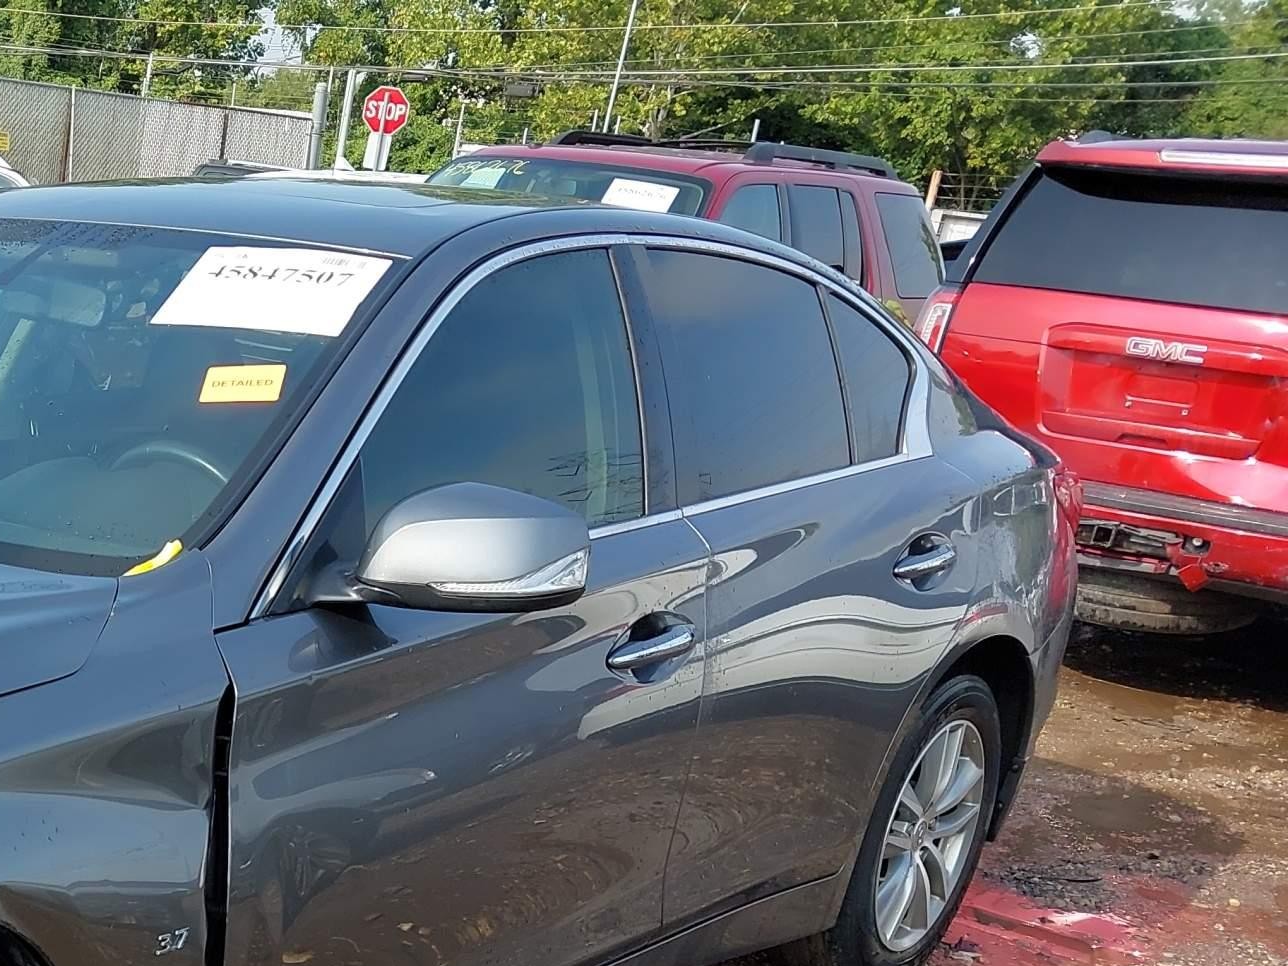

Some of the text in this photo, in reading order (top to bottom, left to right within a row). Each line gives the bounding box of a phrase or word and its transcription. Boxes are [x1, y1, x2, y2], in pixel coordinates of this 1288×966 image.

[365, 100, 406, 121] STOP
[208, 265, 355, 286] 45847507
[1126, 337, 1207, 364] GMC
[211, 379, 274, 388] DETAILED
